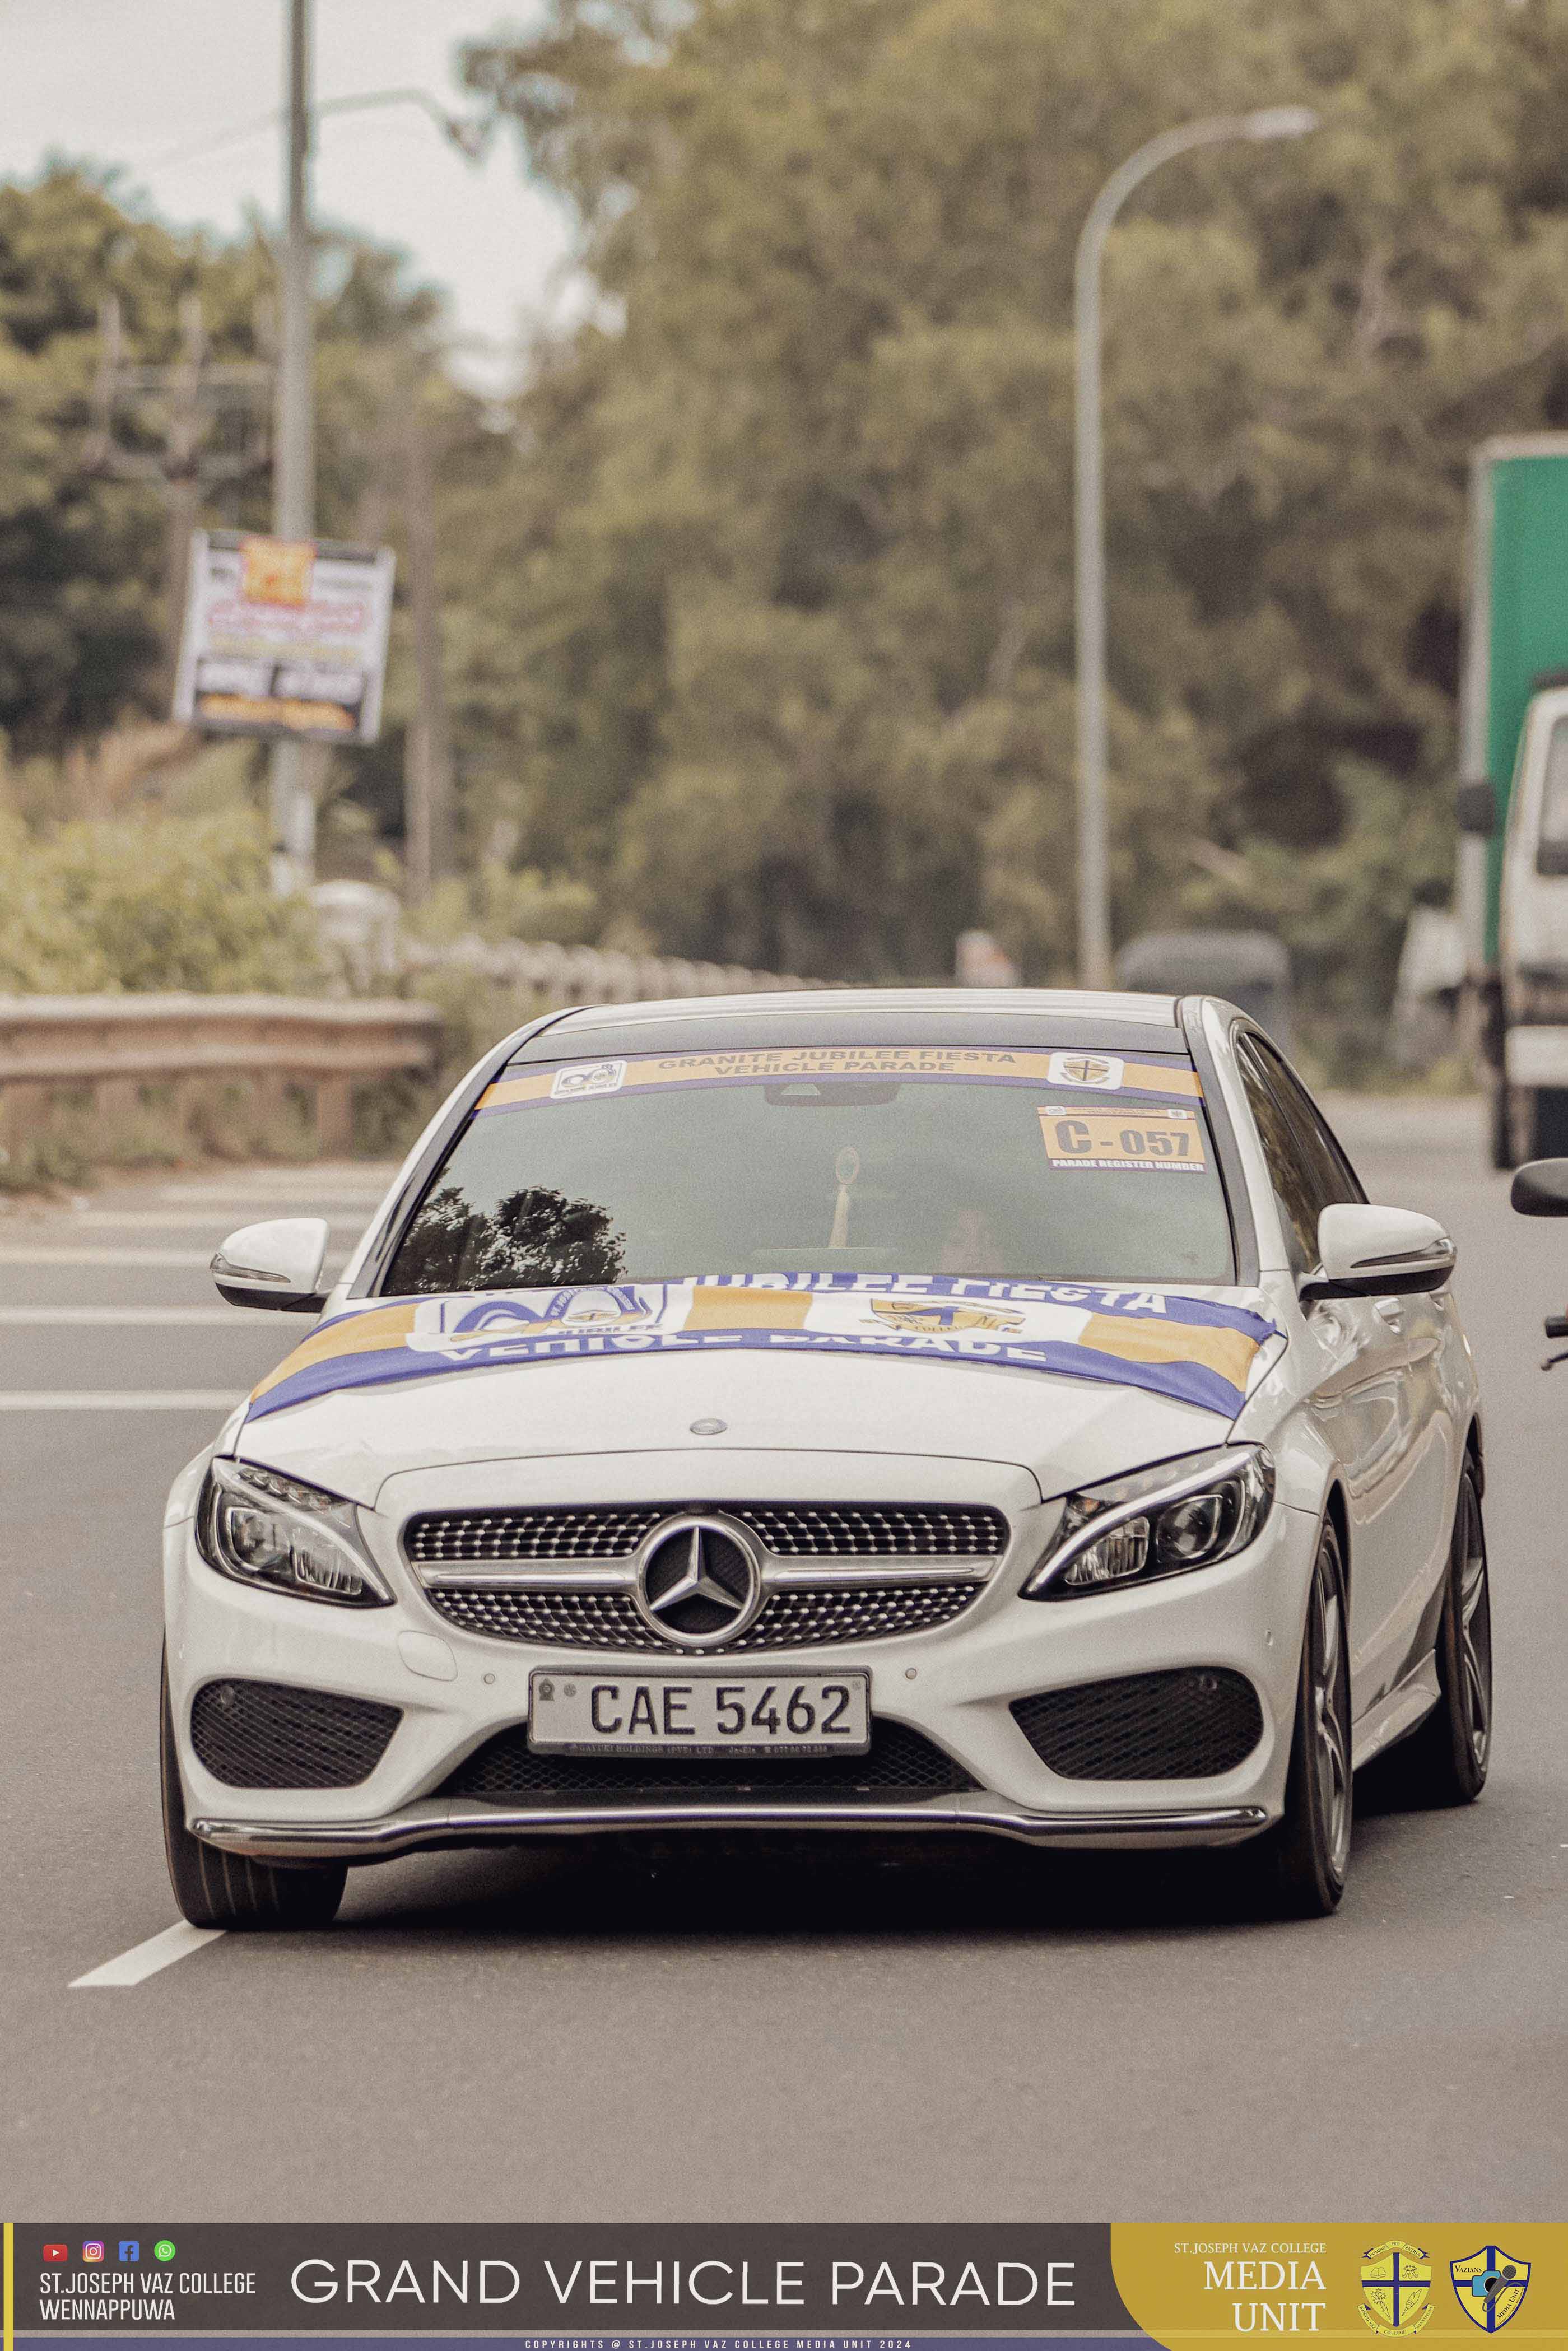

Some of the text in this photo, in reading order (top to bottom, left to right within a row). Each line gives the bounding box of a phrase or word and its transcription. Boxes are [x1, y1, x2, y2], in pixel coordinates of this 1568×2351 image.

[659, 1050, 1017, 1069] GRANITE JUBILEE FIESTA
[715, 1062, 955, 1075] VEHICLE PARADE
[1055, 1120, 1092, 1154] C
[1120, 1129, 1190, 1156] 057
[1051, 1158, 1204, 1172] PARADE REGISTER NUMBER
[591, 1684, 851, 1735] CAE 5462
